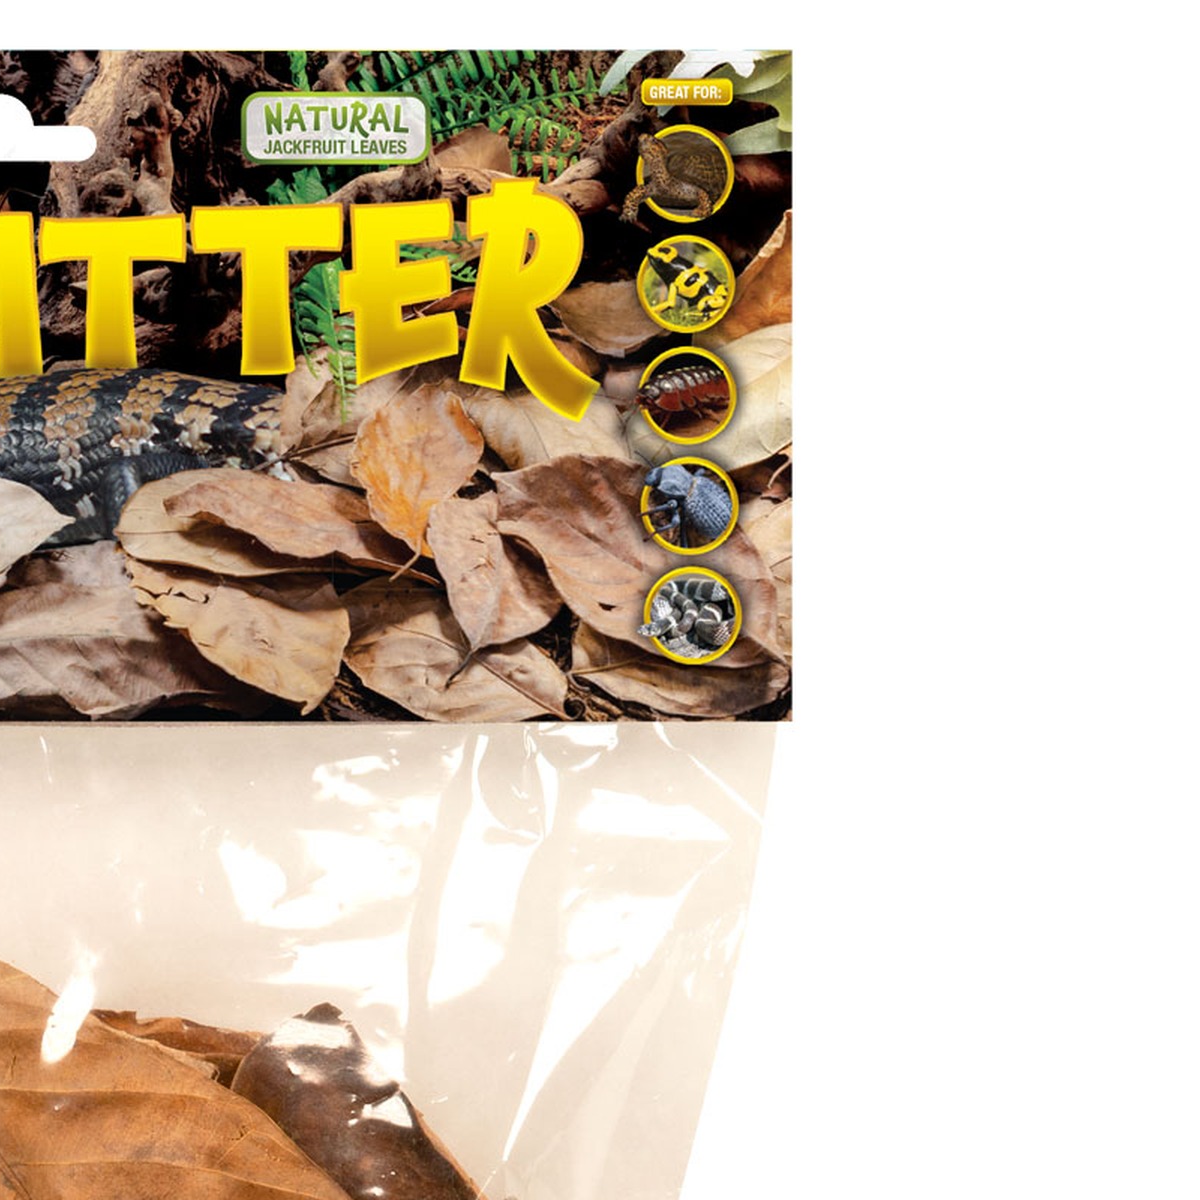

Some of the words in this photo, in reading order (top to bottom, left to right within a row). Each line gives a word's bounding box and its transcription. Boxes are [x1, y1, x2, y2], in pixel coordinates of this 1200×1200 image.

[649, 85, 690, 99] GREAT
[693, 85, 722, 99] FOR:
[264, 101, 409, 138] NATURAL
[264, 139, 346, 155] JACKFRUIT
[351, 139, 407, 155] LEAVES
